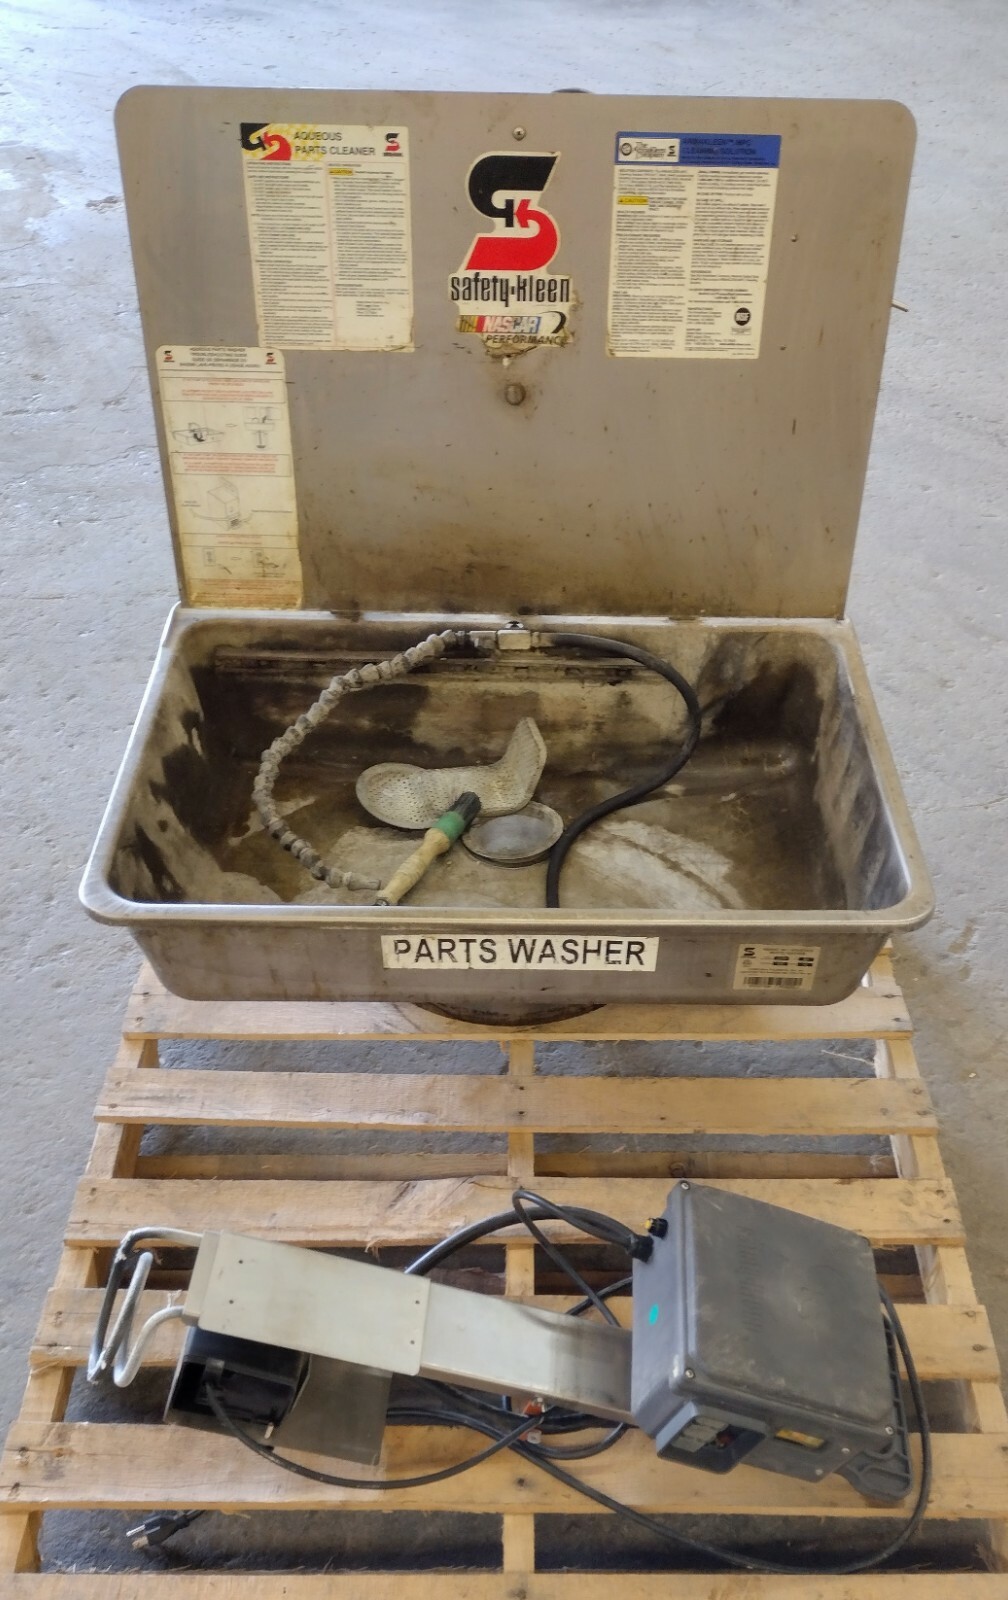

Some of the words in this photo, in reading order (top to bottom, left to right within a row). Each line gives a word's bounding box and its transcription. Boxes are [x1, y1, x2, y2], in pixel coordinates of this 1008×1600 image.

[294, 131, 343, 141] AQUEOUS
[294, 145, 326, 155] PARTS
[329, 147, 376, 156] CLEANER
[483, 315, 540, 334] NASCAR
[393, 938, 498, 964] PARTS
[507, 938, 646, 966] WASHER
